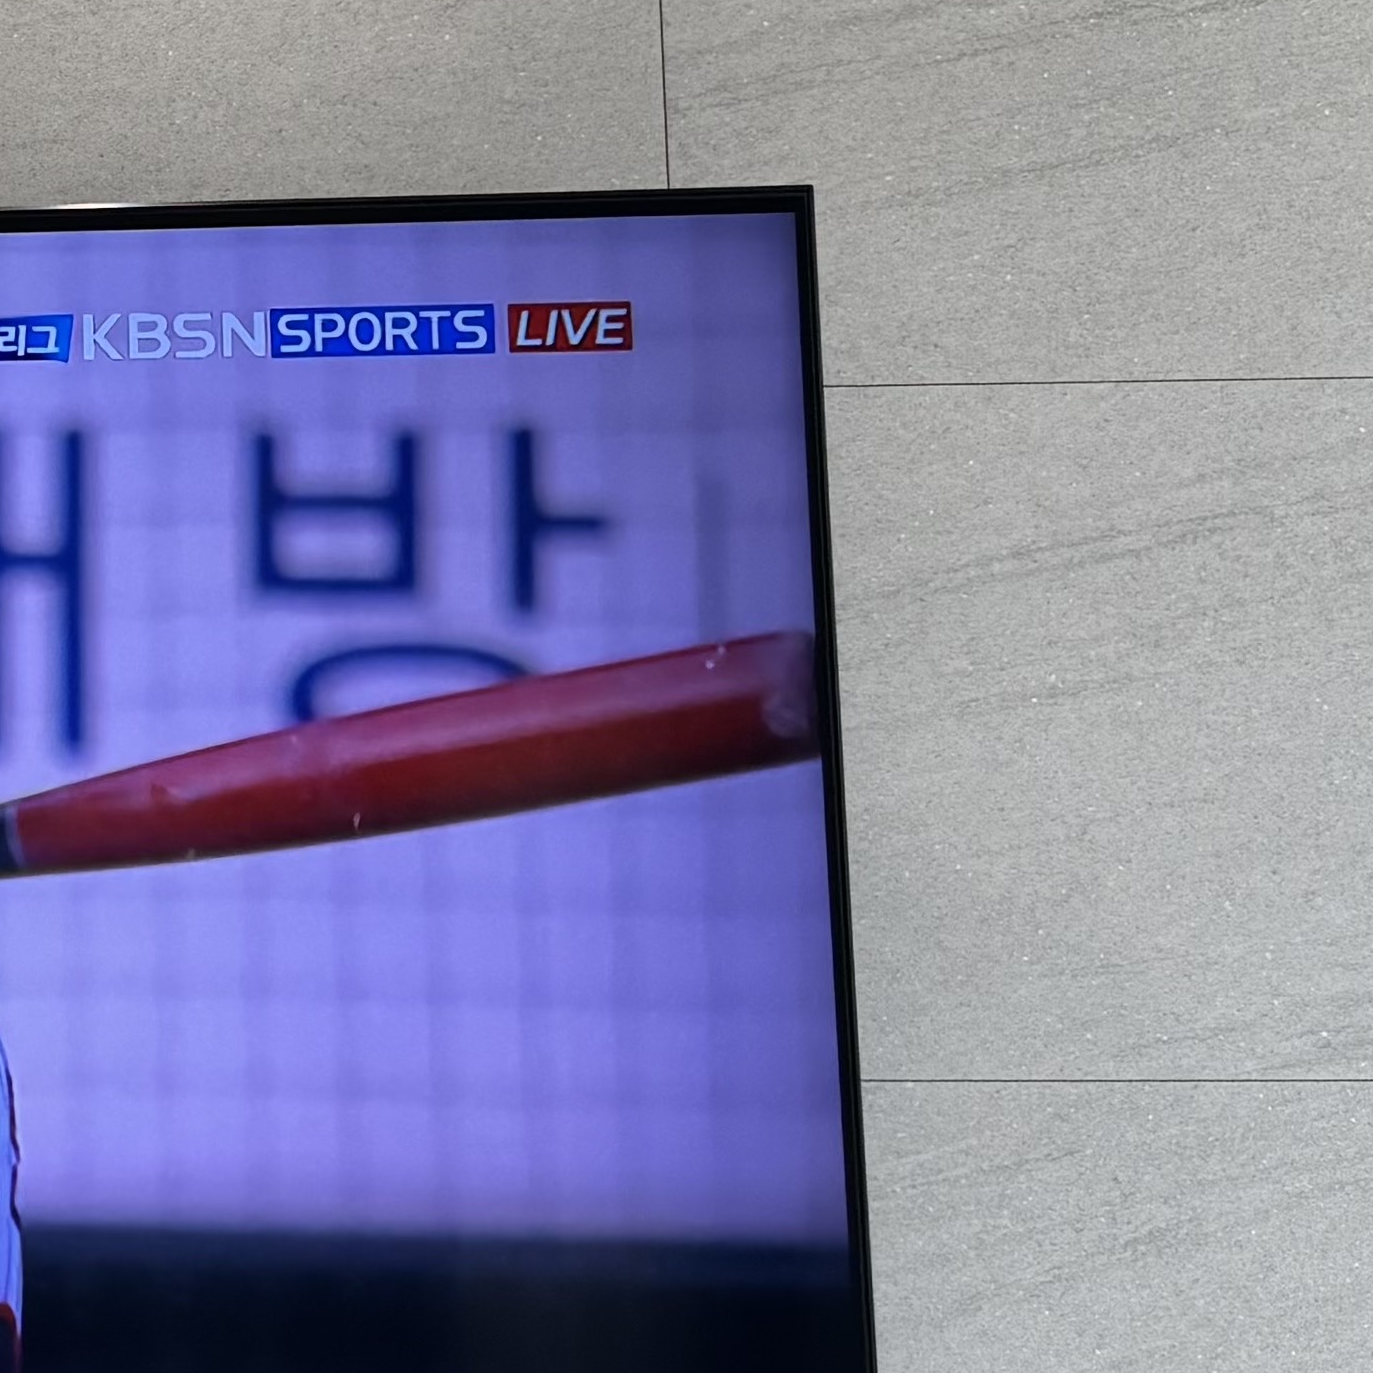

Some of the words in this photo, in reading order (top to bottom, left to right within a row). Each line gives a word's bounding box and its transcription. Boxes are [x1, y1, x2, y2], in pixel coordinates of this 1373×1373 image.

[82, 311, 267, 361] KBSN
[276, 309, 489, 353] SPORTS
[515, 308, 628, 347] LIVE
